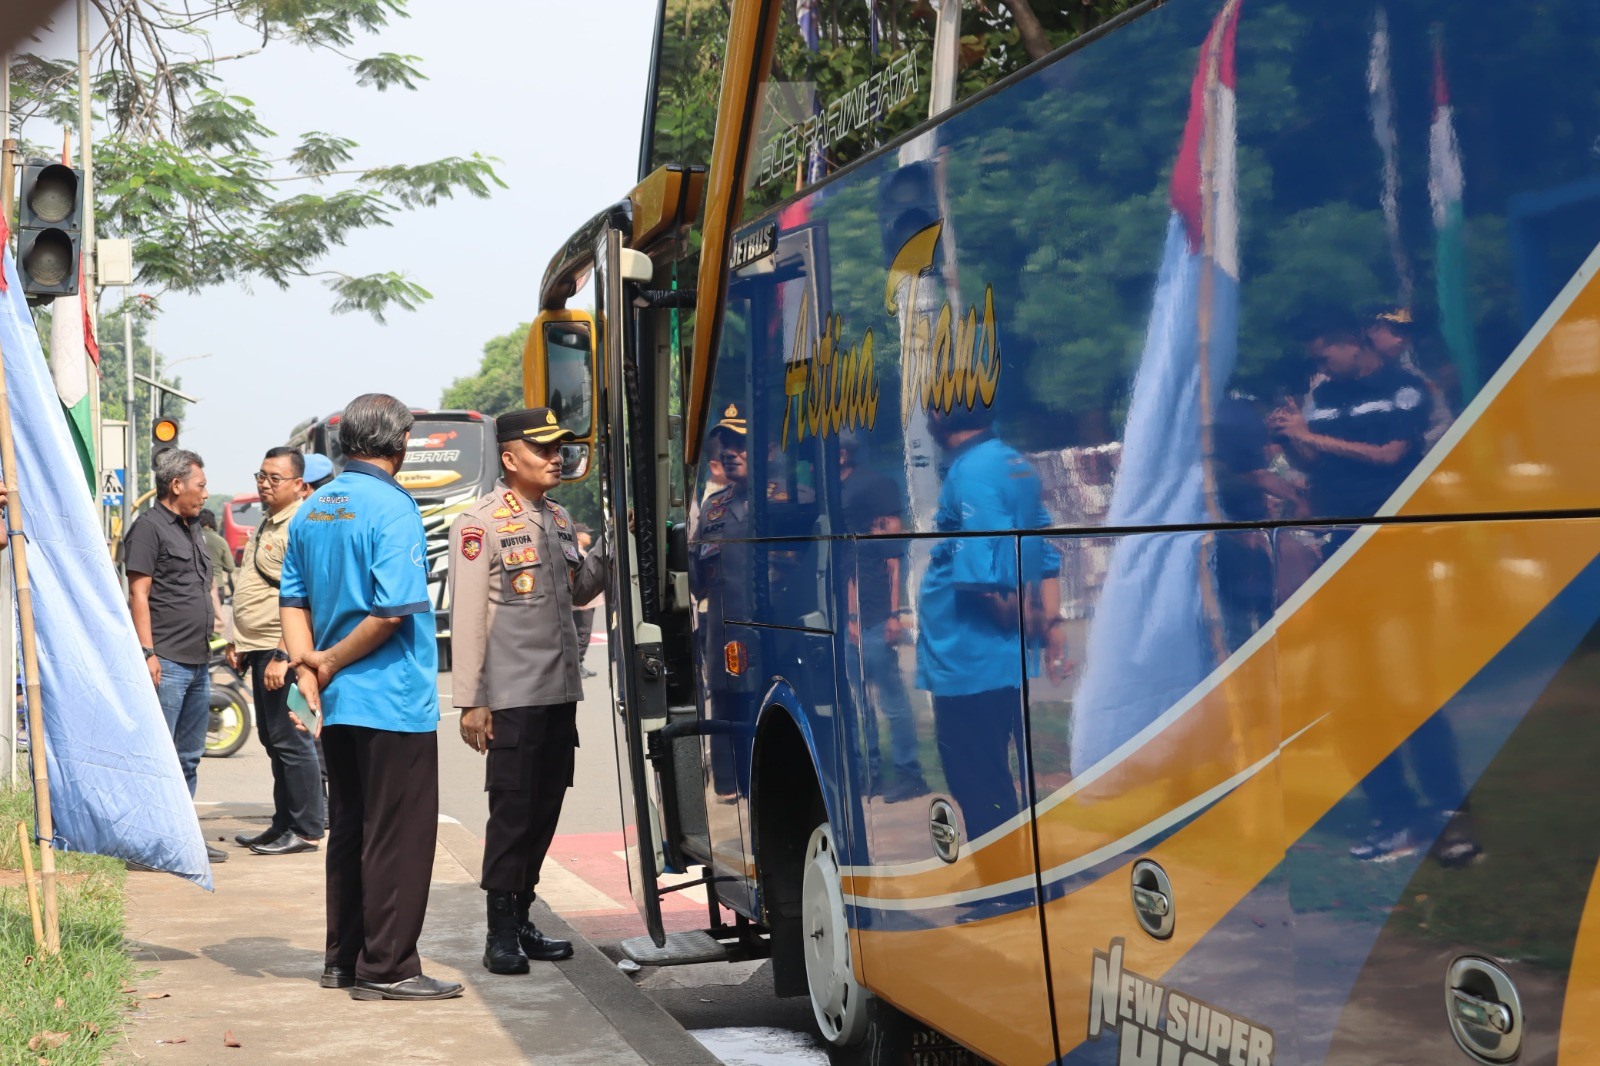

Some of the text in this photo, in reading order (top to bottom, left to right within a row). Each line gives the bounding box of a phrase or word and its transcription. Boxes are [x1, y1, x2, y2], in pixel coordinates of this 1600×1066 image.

[730, 224, 774, 268] JETBUS
[782, 218, 1000, 452] Astina Trans
[1166, 993, 1273, 1066] SUPER
